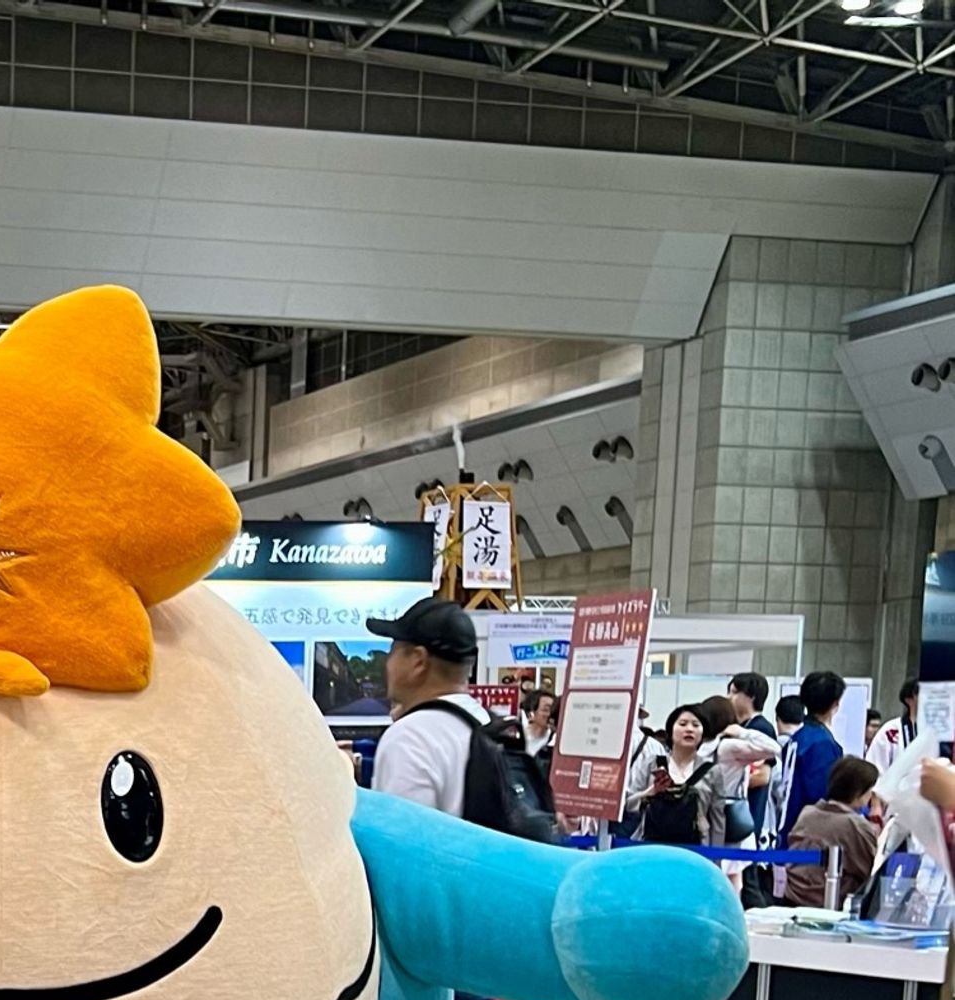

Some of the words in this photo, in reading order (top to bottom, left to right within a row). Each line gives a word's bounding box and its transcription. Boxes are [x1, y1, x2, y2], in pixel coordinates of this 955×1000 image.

[219, 532, 261, 568] 市
[269, 538, 387, 565] Kanazawa
[473, 505, 501, 567] 足湯
